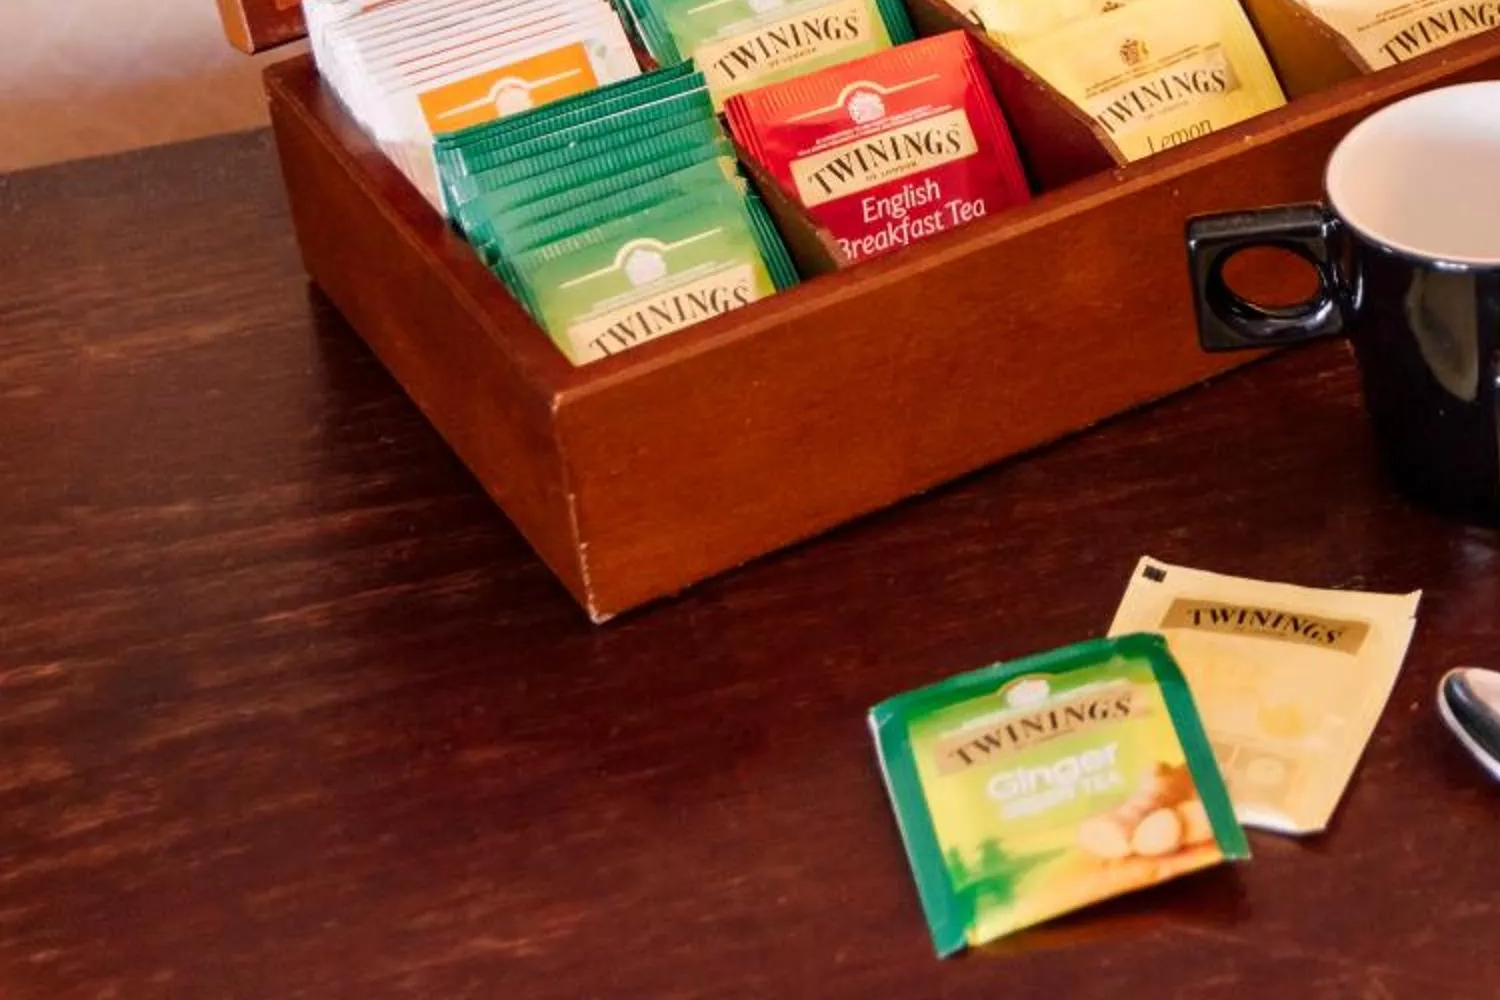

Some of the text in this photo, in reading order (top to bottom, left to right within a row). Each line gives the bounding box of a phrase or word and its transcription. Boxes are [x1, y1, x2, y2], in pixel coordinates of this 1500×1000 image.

[713, 14, 860, 81] TWININGS
[1095, 68, 1227, 135] TWININGS
[807, 128, 962, 195] TWININGS
[862, 177, 942, 224] English
[944, 198, 987, 226] Tea
[589, 281, 753, 356] TWININGS
[1188, 607, 1343, 645] TWININGS
[948, 694, 1133, 767] TWININGS
